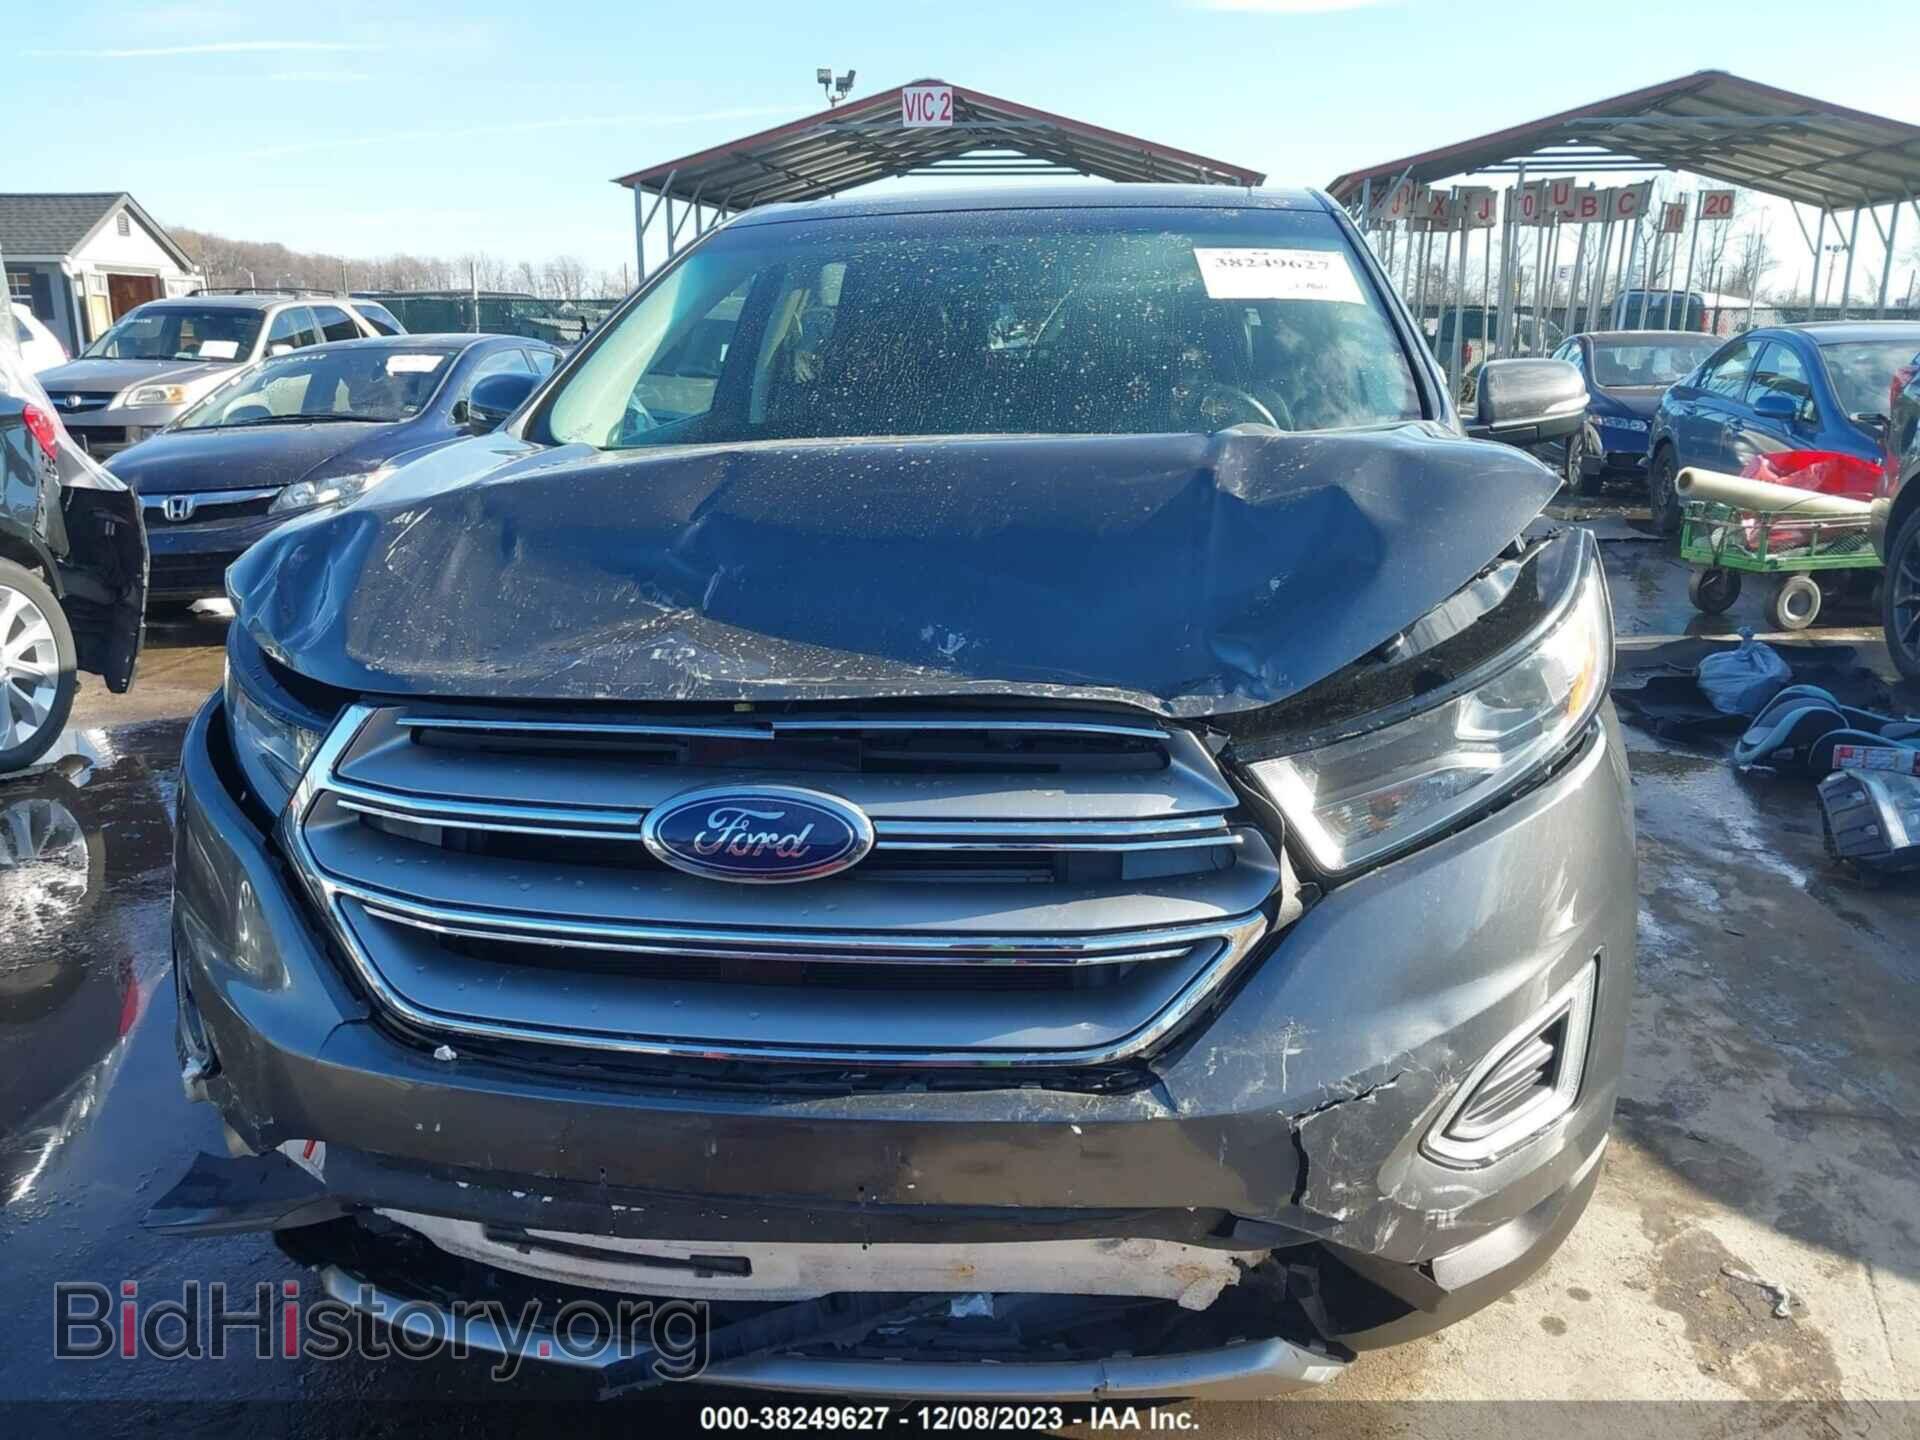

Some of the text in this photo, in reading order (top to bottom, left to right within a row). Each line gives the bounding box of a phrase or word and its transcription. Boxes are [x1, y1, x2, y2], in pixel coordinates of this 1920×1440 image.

[904, 92, 951, 122] VIC 2
[1554, 183, 1569, 205] U
[1618, 193, 1635, 214] C
[1433, 195, 1445, 215] X
[1478, 198, 1490, 220] J
[1581, 197, 1597, 217] B
[1705, 196, 1731, 215] 20
[694, 807, 816, 858] Ford
